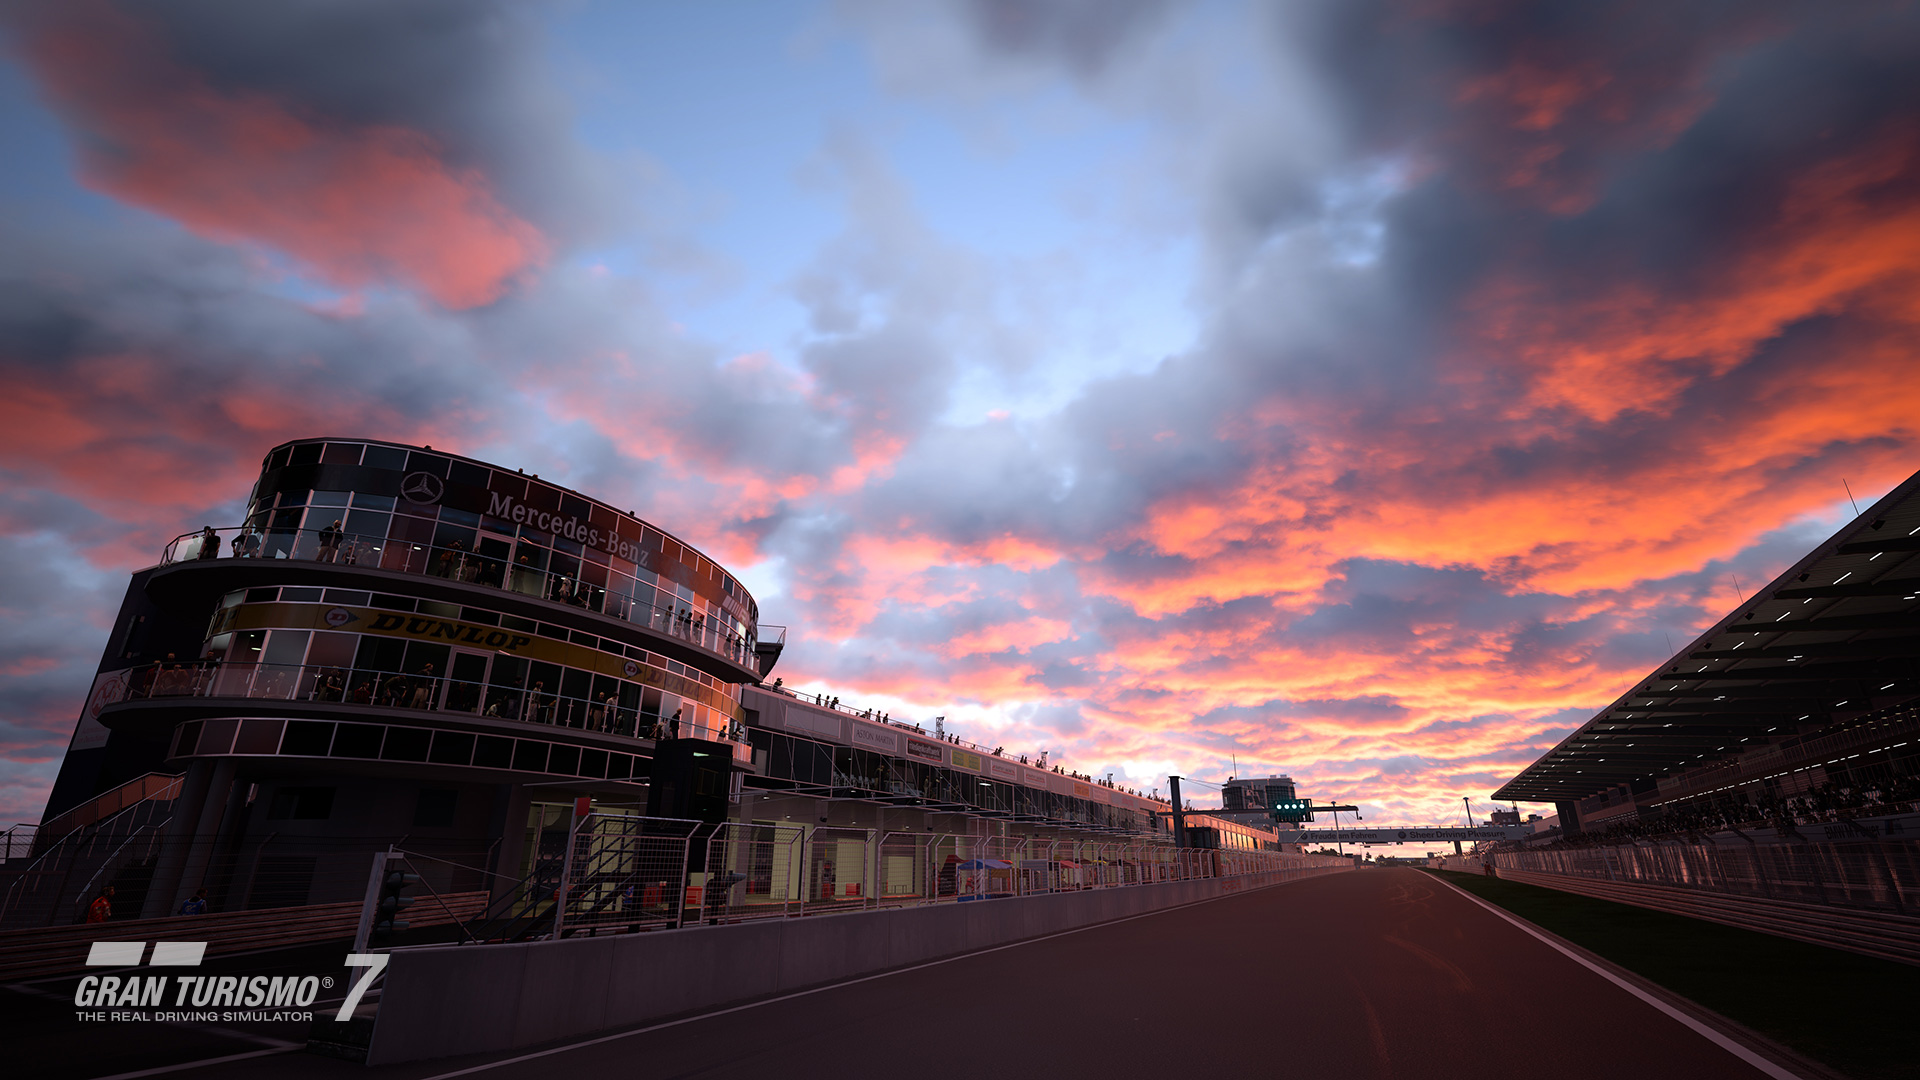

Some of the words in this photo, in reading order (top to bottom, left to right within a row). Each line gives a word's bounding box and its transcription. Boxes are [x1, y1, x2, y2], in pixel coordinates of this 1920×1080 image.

[485, 490, 650, 567] Mercedes-Benz
[367, 612, 531, 650] DUNLOP
[646, 668, 711, 703] DUNLOP
[856, 729, 874, 741] ASTON
[875, 733, 895, 745] MARTIN
[1409, 831, 1435, 839] Sheer
[1435, 831, 1467, 840] Driving
[1824, 825, 1845, 840] BMW
